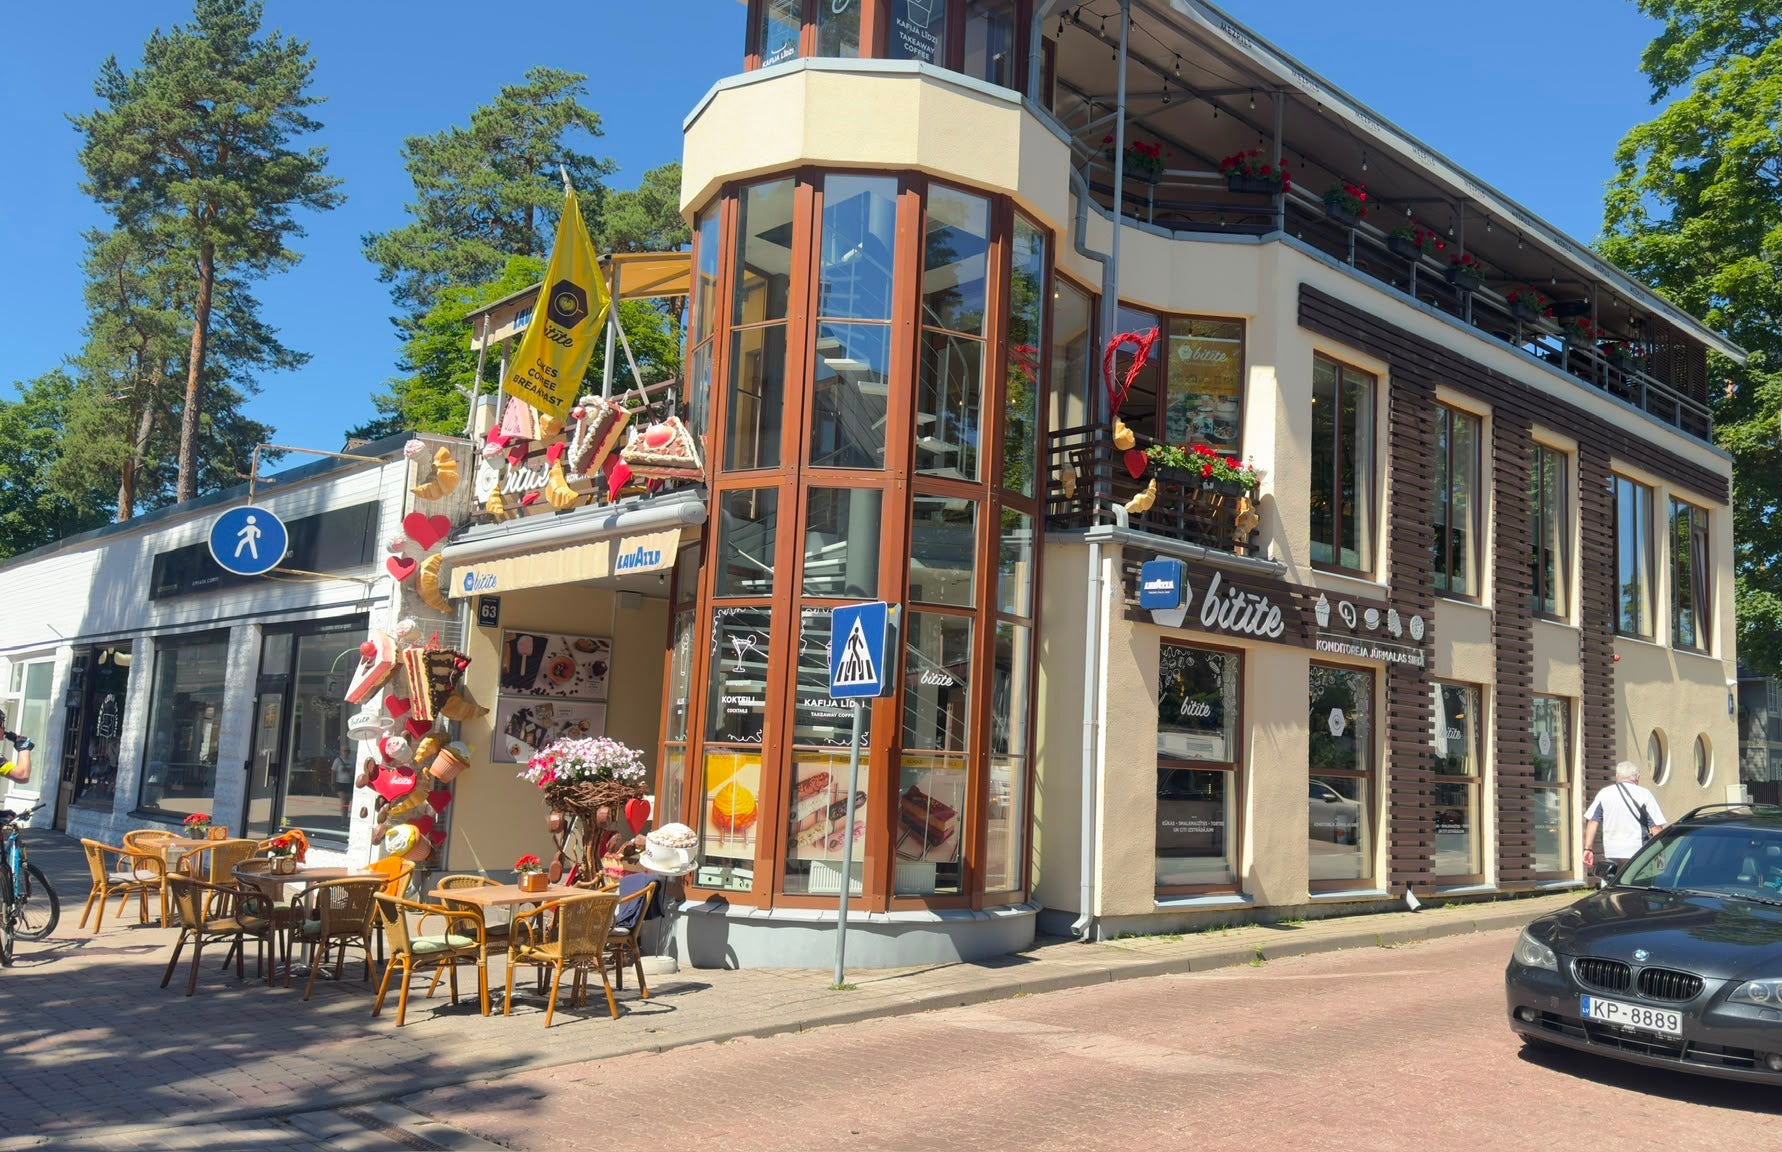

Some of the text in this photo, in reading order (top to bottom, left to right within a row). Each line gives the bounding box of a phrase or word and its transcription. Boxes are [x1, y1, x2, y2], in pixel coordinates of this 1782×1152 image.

[896, 17, 920, 35] KAFIJA
[899, 32, 935, 53] TAKEAWAY
[904, 43, 930, 61] COFFEE
[544, 325, 574, 348] itīte
[481, 604, 497, 618] 63
[1201, 571, 1285, 639] bitīte
[1316, 639, 1369, 658] KONDITOREJA
[1370, 647, 1408, 664] JŪRMALAS
[921, 669, 954, 687] bitīte
[721, 695, 755, 704] KOKTEILI
[804, 698, 865, 709] KAFIJA LĪDI
[1181, 695, 1211, 718] bitīte
[1593, 999, 1678, 1031] KP-8889
